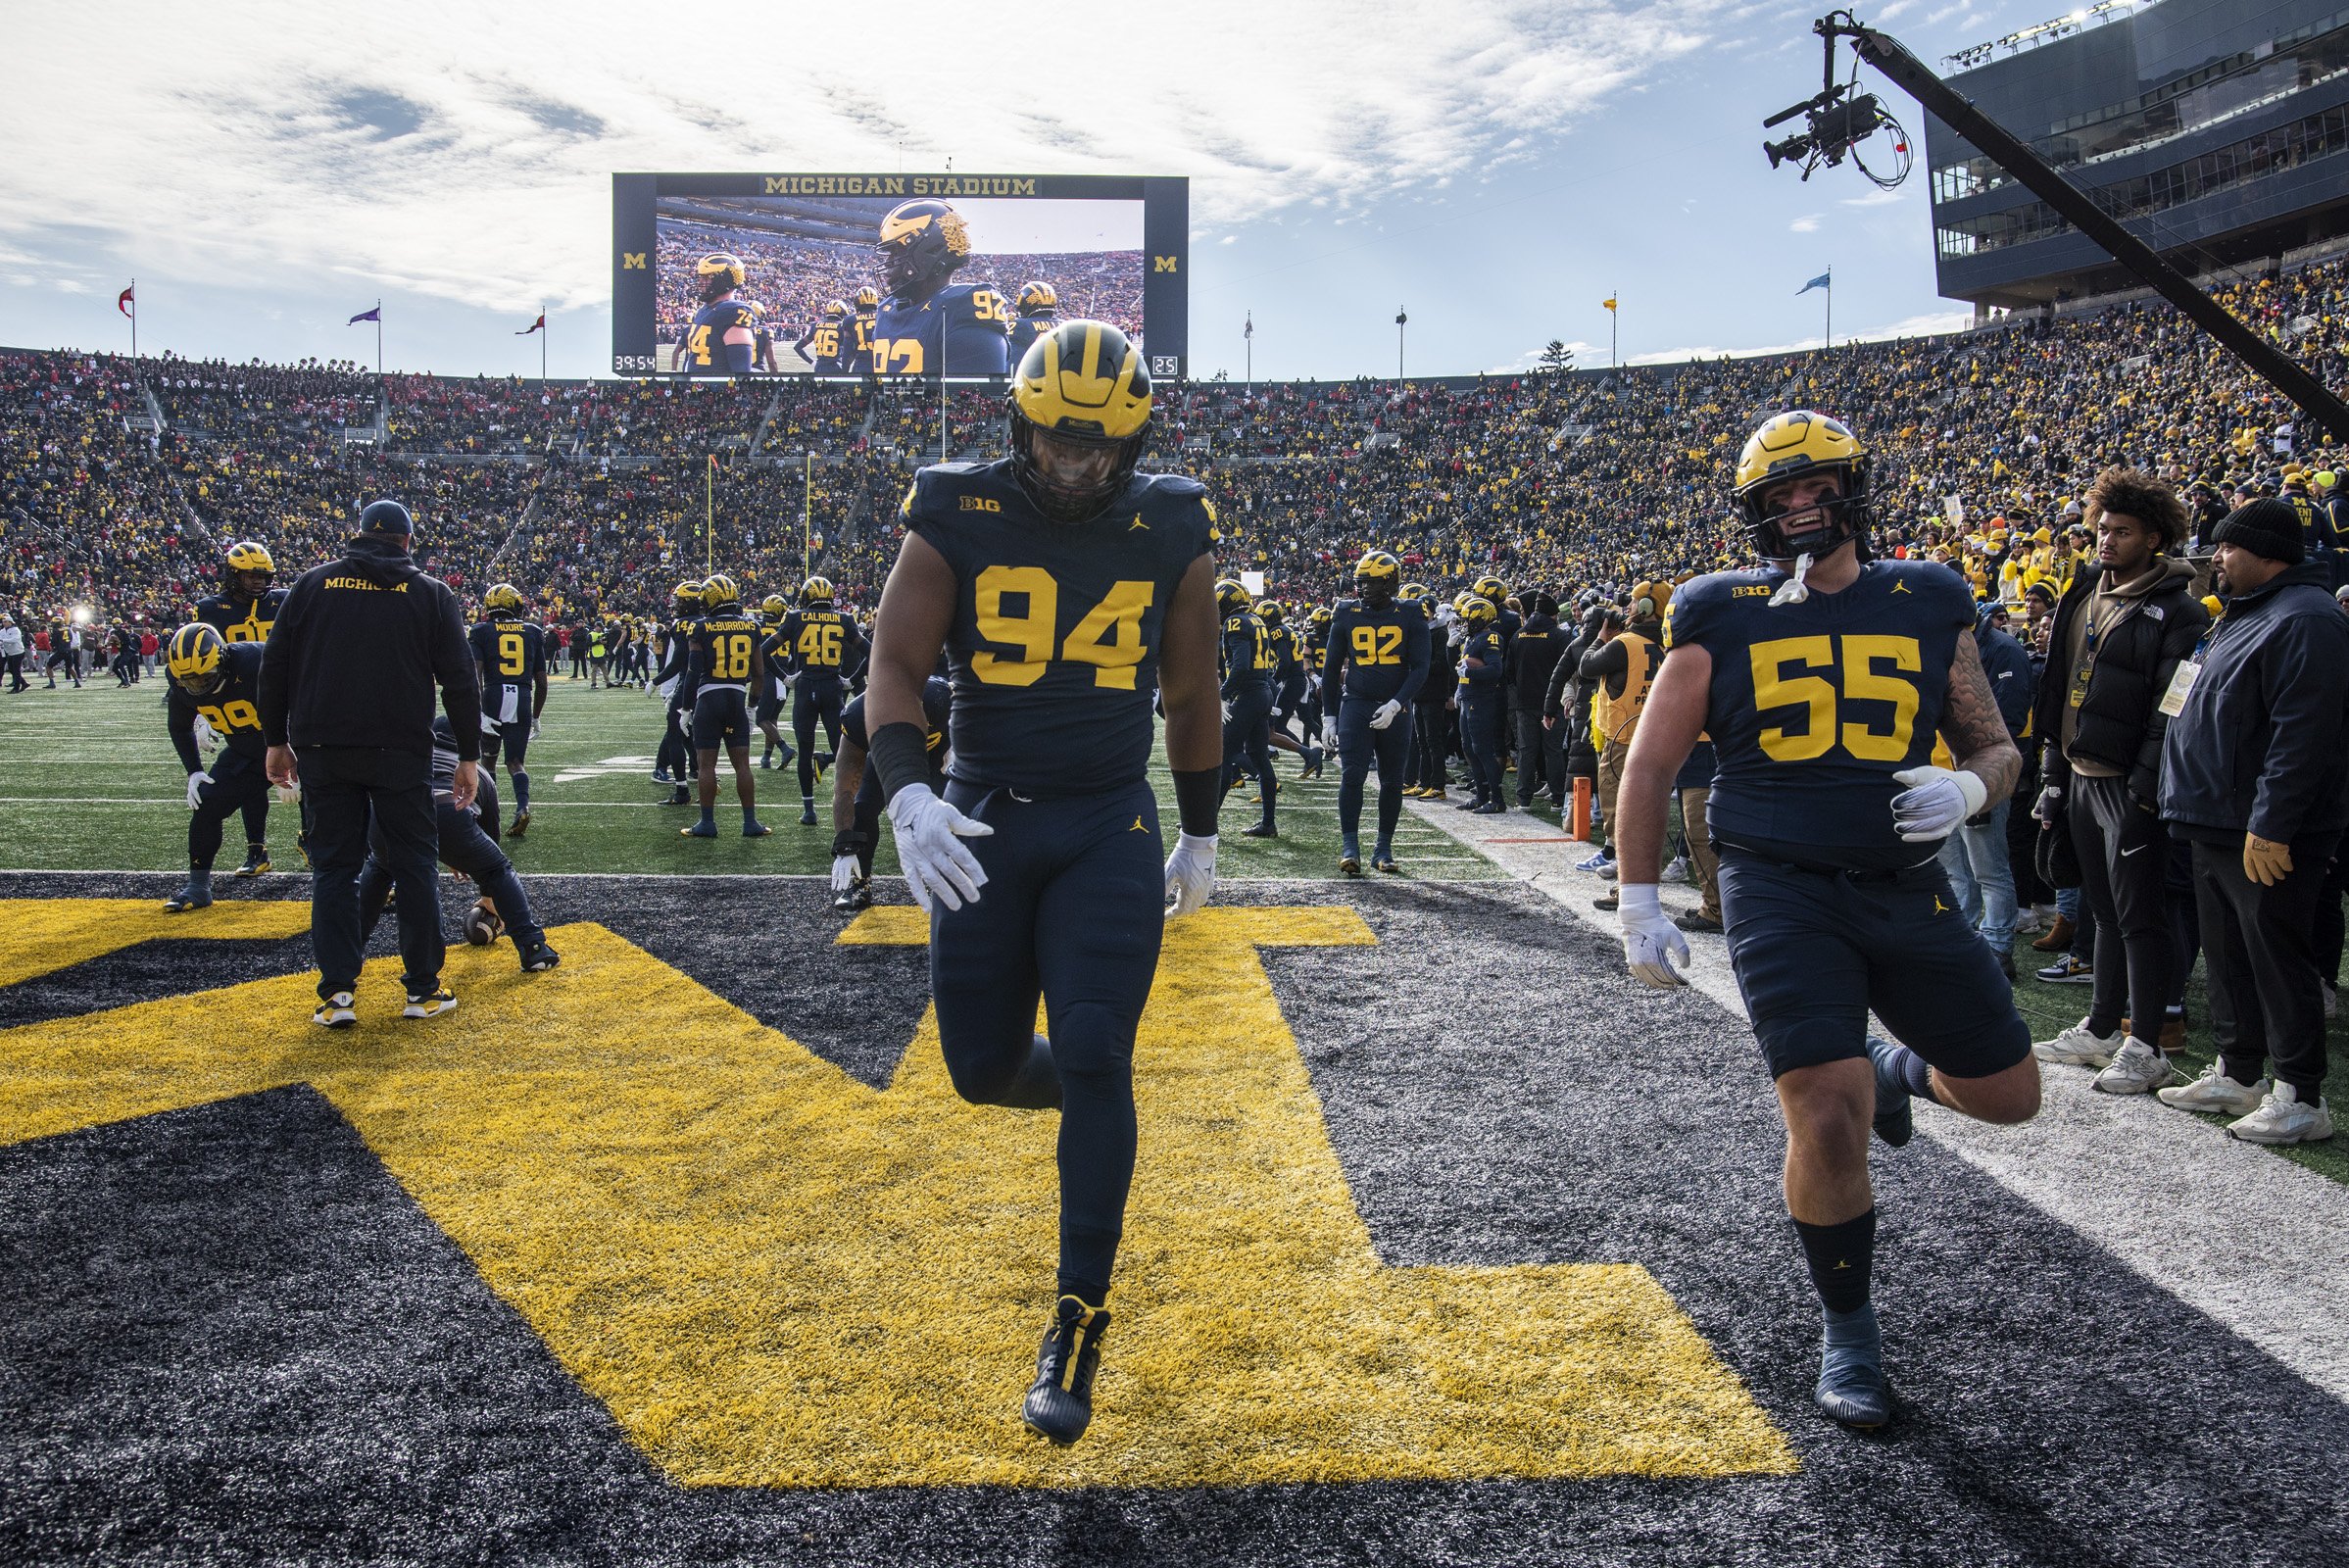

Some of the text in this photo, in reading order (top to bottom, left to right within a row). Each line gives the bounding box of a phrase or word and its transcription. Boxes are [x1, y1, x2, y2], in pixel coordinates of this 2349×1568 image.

[765, 176, 1035, 196] MICHIGAN STADIUM
[623, 252, 647, 270] M
[1154, 256, 1177, 272] M
[973, 290, 1007, 322] 92
[735, 309, 754, 327] 74
[814, 329, 840, 358] 46
[615, 355, 656, 370] 39:54
[1155, 359, 1175, 373] 25
[801, 612, 841, 623] CALHOUN
[1227, 617, 1242, 632] 12
[495, 622, 525, 632] MOORE
[971, 564, 1154, 690] 94
[1271, 628, 1284, 641] 20
[797, 623, 845, 666] 46
[1351, 625, 1403, 666] 92
[1487, 633, 1499, 645] 41
[499, 633, 525, 676] 9
[711, 634, 753, 679] 18
[1749, 634, 1922, 762] 55
